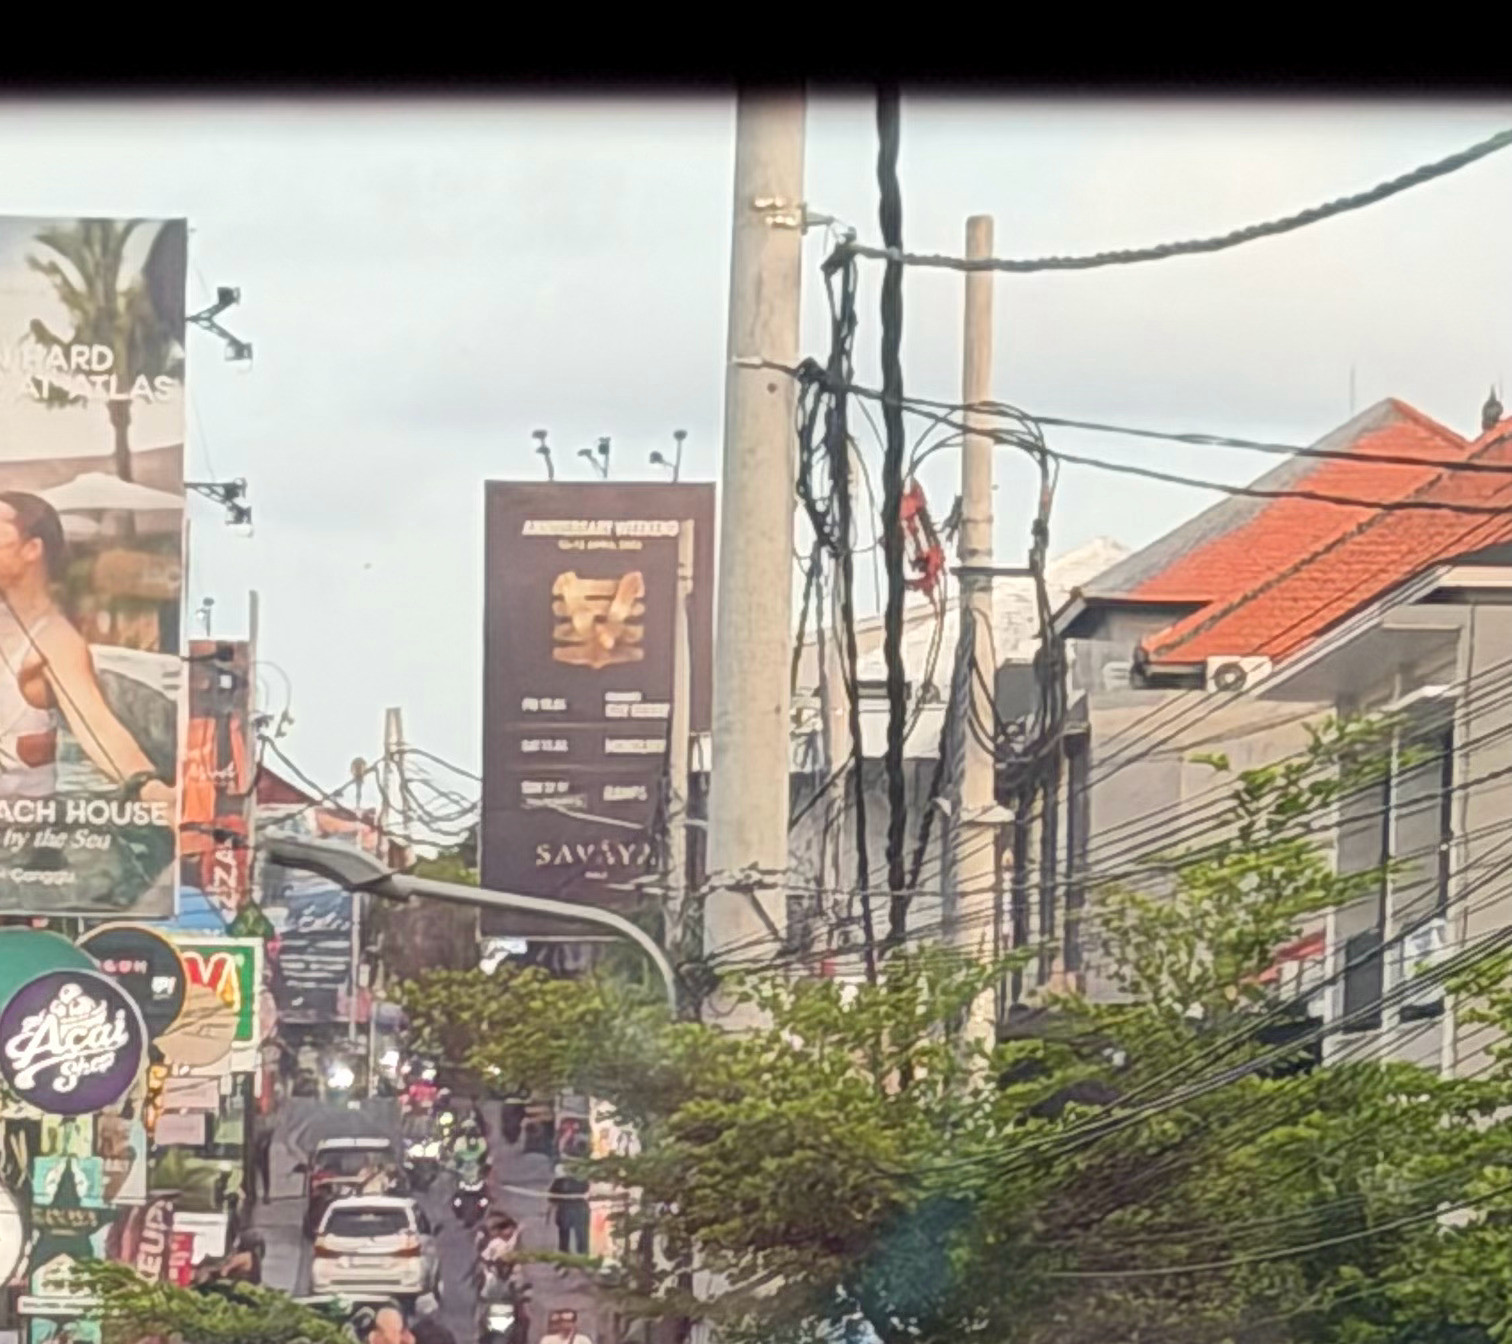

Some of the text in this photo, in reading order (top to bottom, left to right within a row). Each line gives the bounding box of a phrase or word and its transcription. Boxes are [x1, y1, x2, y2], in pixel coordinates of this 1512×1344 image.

[19, 344, 113, 372] HARD
[68, 373, 182, 402] ATLAS
[65, 799, 171, 827] HOUSE
